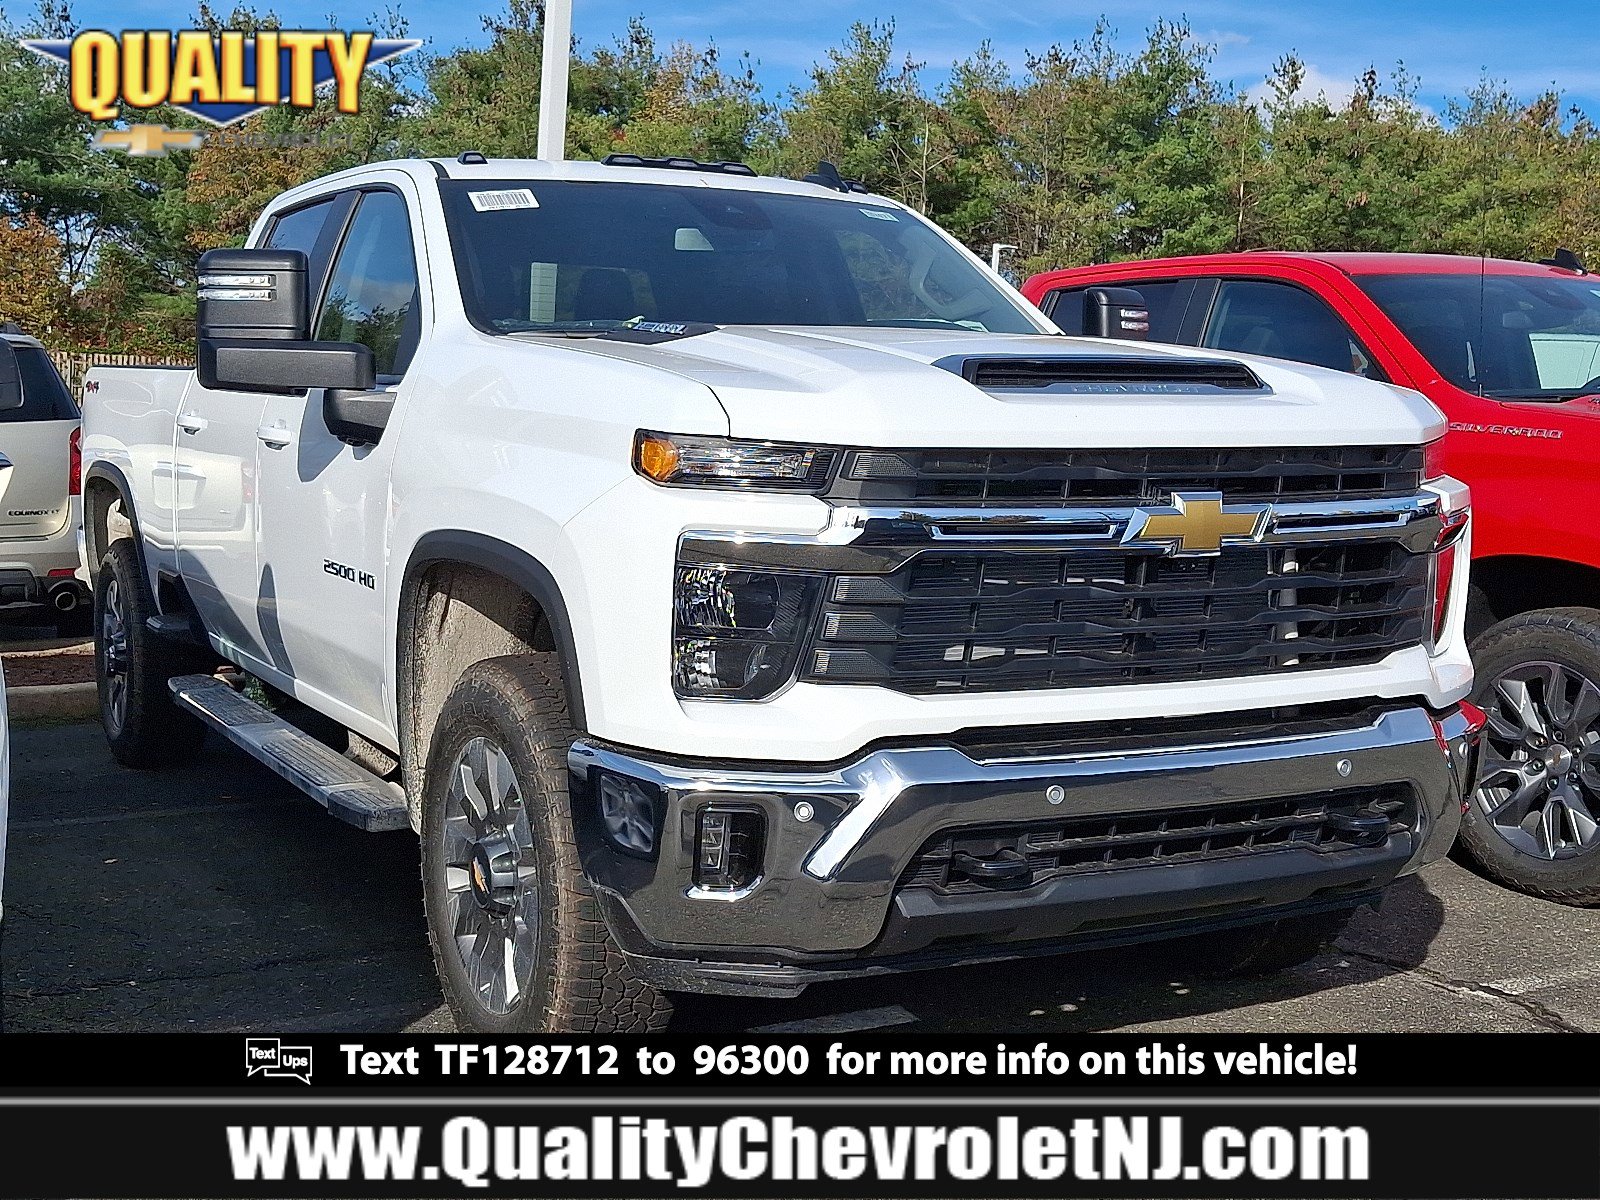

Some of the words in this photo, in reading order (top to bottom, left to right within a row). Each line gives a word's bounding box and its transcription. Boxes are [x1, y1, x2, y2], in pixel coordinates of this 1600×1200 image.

[1449, 421, 1564, 440] SILVERADO
[8, 509, 49, 517] EQUINOX
[323, 558, 356, 583] 2500
[358, 569, 376, 591] HD
